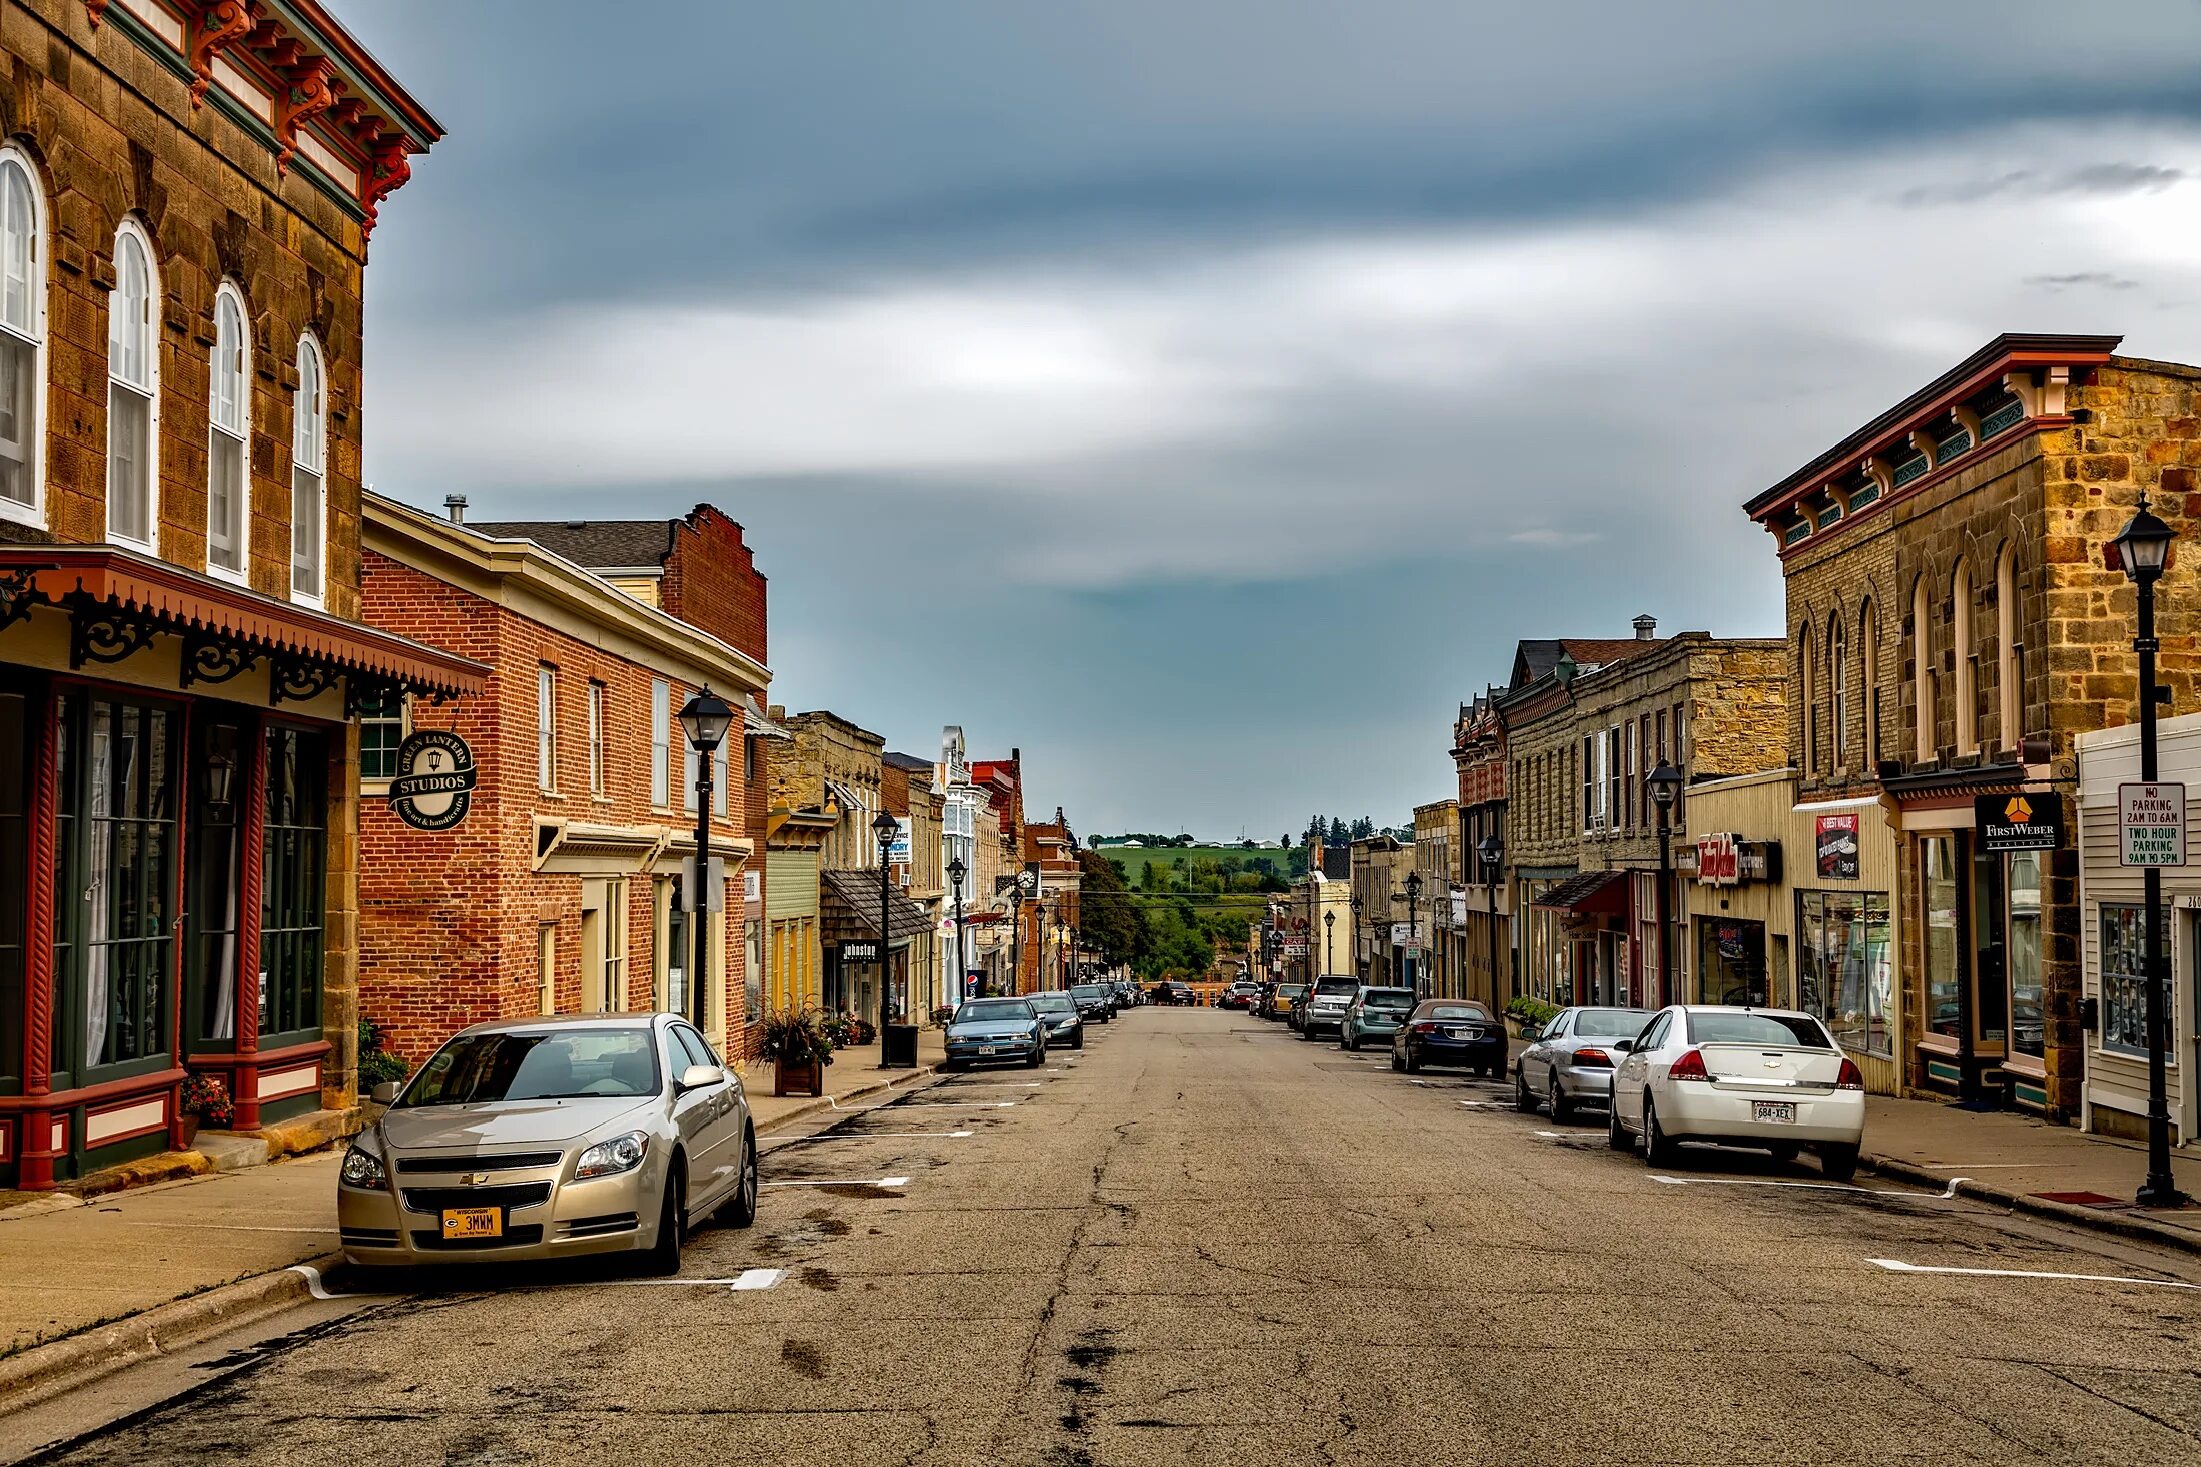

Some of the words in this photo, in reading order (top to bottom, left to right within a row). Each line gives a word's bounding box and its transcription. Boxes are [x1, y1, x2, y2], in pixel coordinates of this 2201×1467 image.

[402, 739, 423, 772] GREEN
[425, 735, 467, 764] LANTERN
[400, 776, 466, 794] STUDIOS
[2145, 787, 2158, 798] NO
[2132, 799, 2172, 811] PARKING
[402, 800, 412, 816] fine
[410, 813, 422, 824] art
[429, 796, 464, 827] handicrafts
[2127, 812, 2145, 823] 2AM
[2147, 812, 2158, 823] TO
[2160, 812, 2178, 823] 6AM
[1827, 817, 1837, 828] BEST
[1837, 816, 1852, 828] VALUE
[2128, 827, 2148, 839] TWO
[2151, 827, 2177, 839] HOUR
[2133, 840, 2173, 852] PARKING
[2128, 853, 2146, 863] 9AM
[2148, 853, 2158, 863] TO
[2160, 853, 2178, 863] 5PM
[1758, 1107, 1790, 1120] 684-XEX
